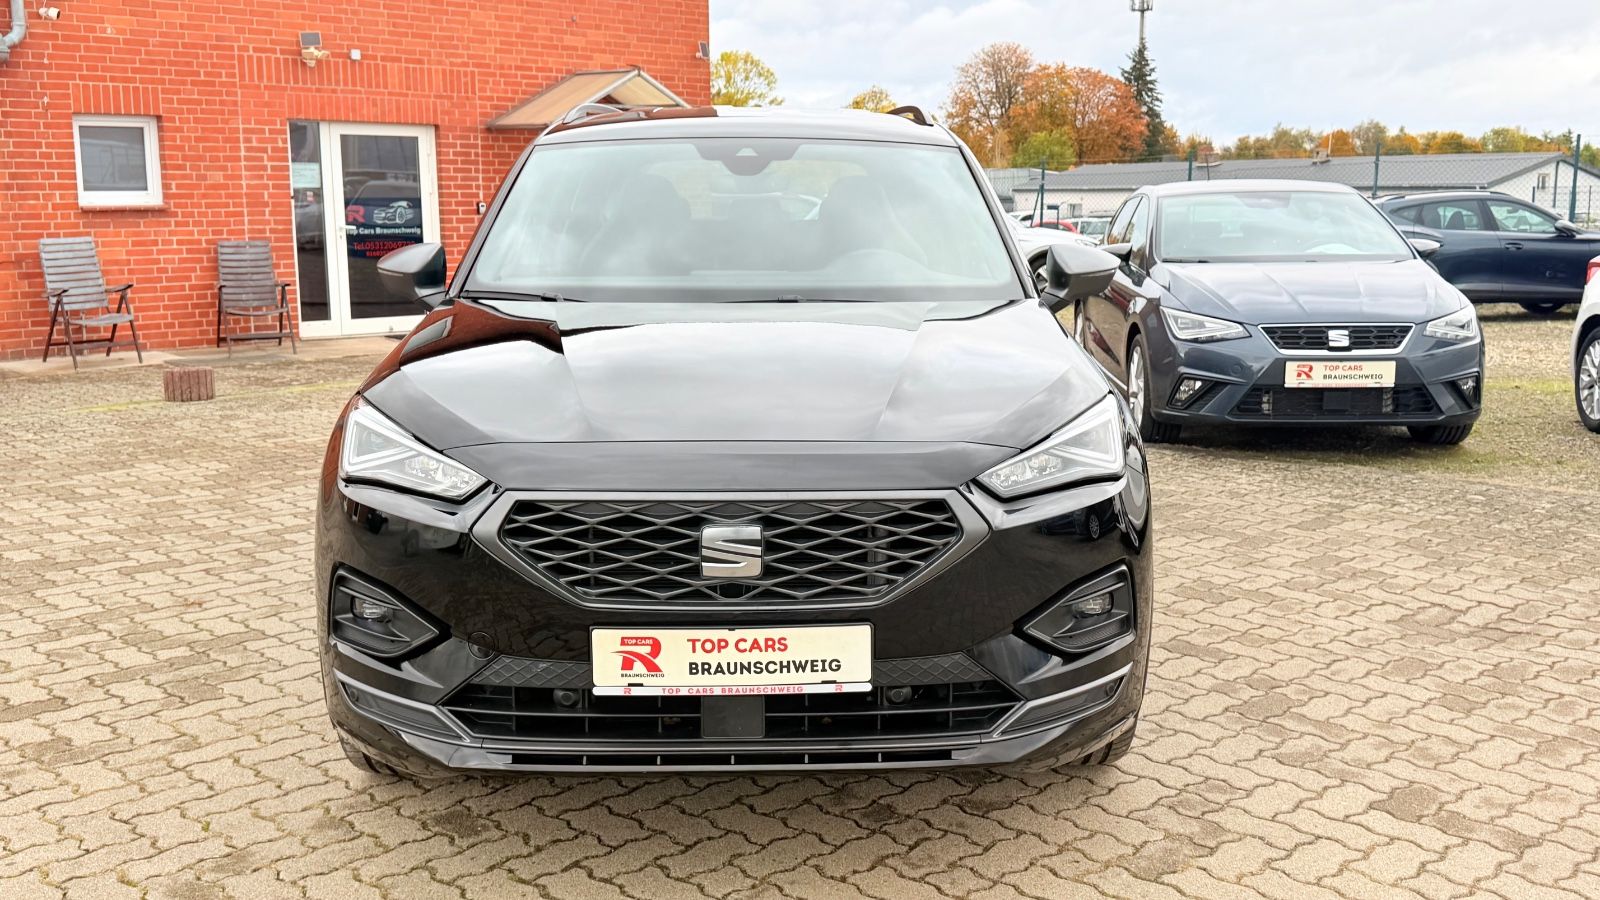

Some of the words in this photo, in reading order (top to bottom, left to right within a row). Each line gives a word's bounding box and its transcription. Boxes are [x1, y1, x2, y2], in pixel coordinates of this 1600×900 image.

[359, 227, 374, 235] Cars
[375, 227, 421, 236] Braunschweig
[687, 638, 729, 654] TOP
[735, 637, 789, 653] CARS
[688, 658, 842, 676] BRAUNSCHWEIG
[688, 687, 714, 695] CARS
[721, 686, 804, 694] BRAUNSCHWEIG
